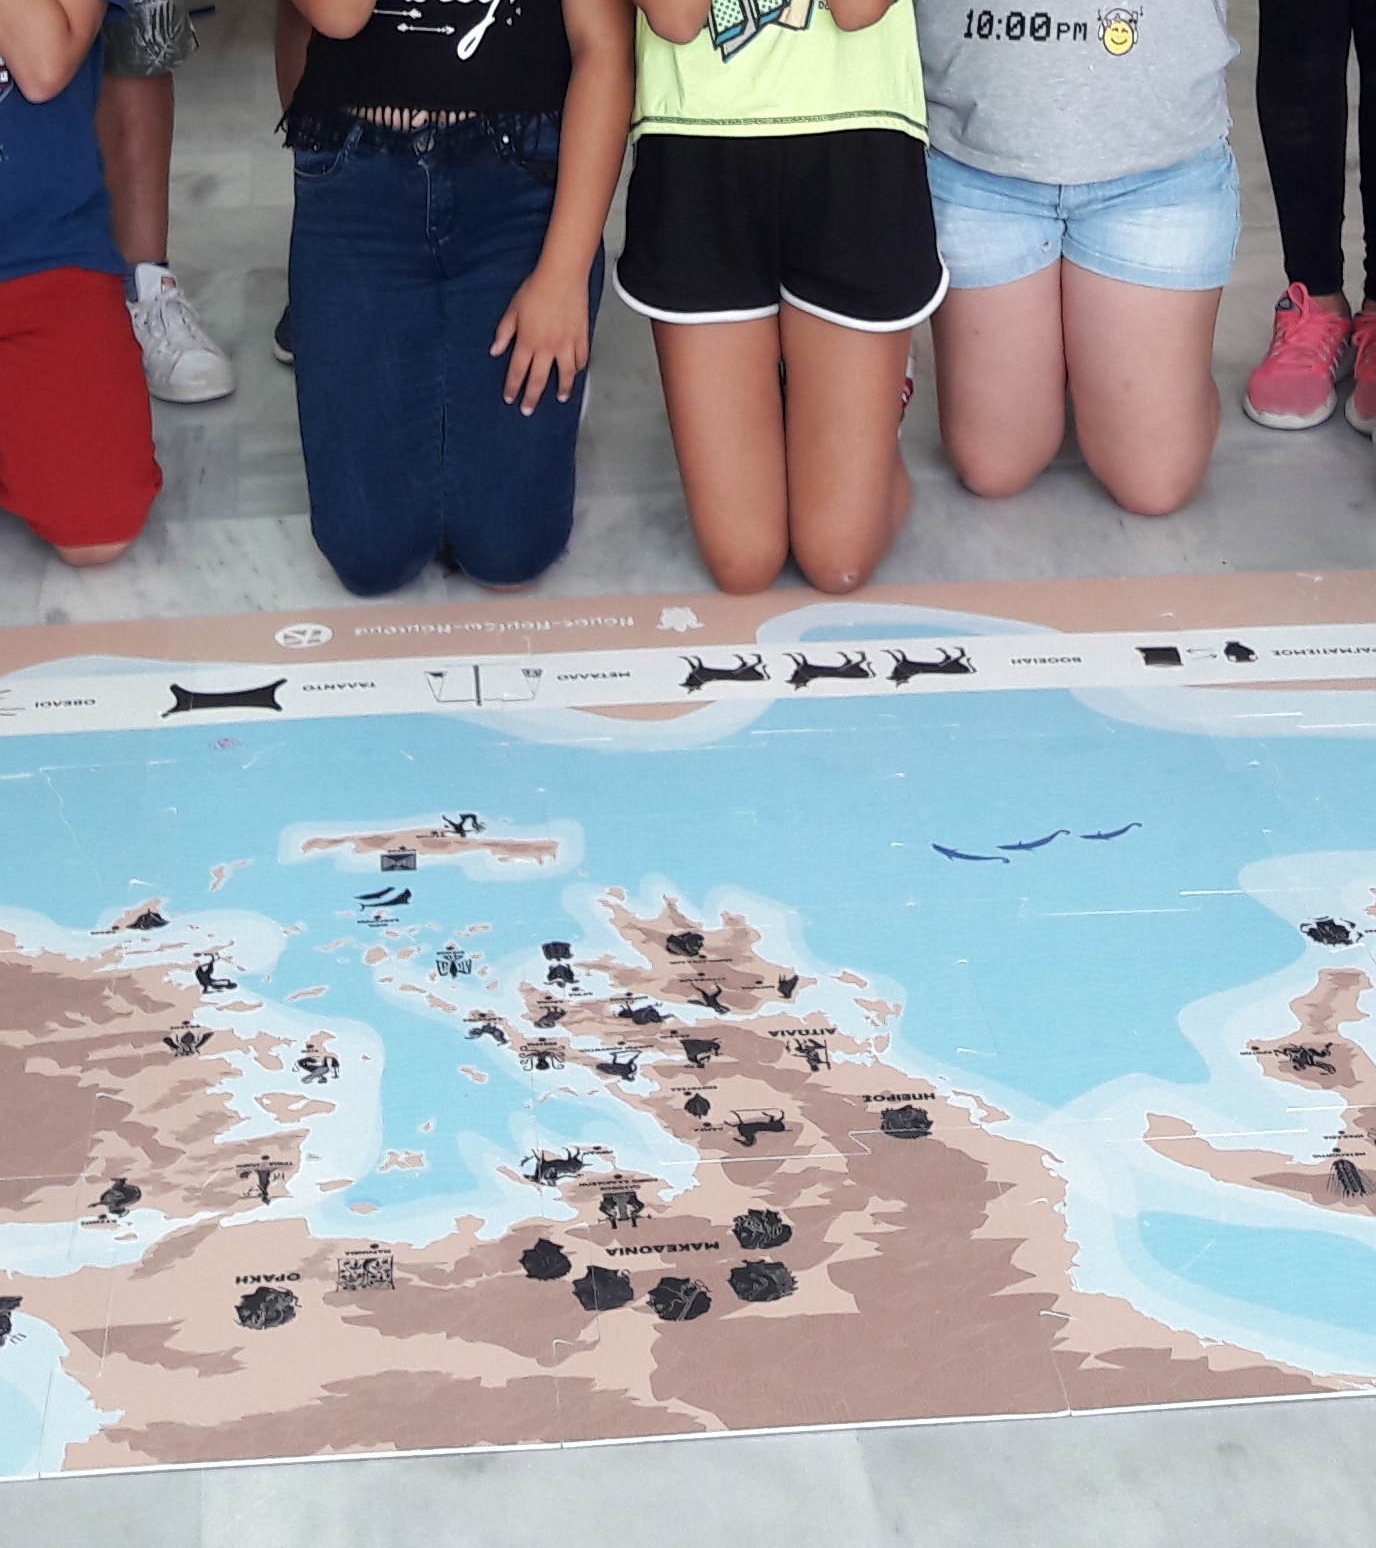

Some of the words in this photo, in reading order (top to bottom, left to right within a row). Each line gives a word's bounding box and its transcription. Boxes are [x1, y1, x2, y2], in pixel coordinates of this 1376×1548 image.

[556, 671, 631, 681] ΜΕΤΑΛΛΟ
[301, 681, 376, 692] ΤΑΛΑΝΤΟ
[767, 1027, 837, 1038] ΑΙΤΩΛΙΑ
[861, 1092, 936, 1103] ΗΠΕΙΡΟΣ
[604, 1241, 721, 1257] ΜΑΚΕΔΟΝΙΑ
[234, 1272, 302, 1285] ΘΡΑΚΗ
